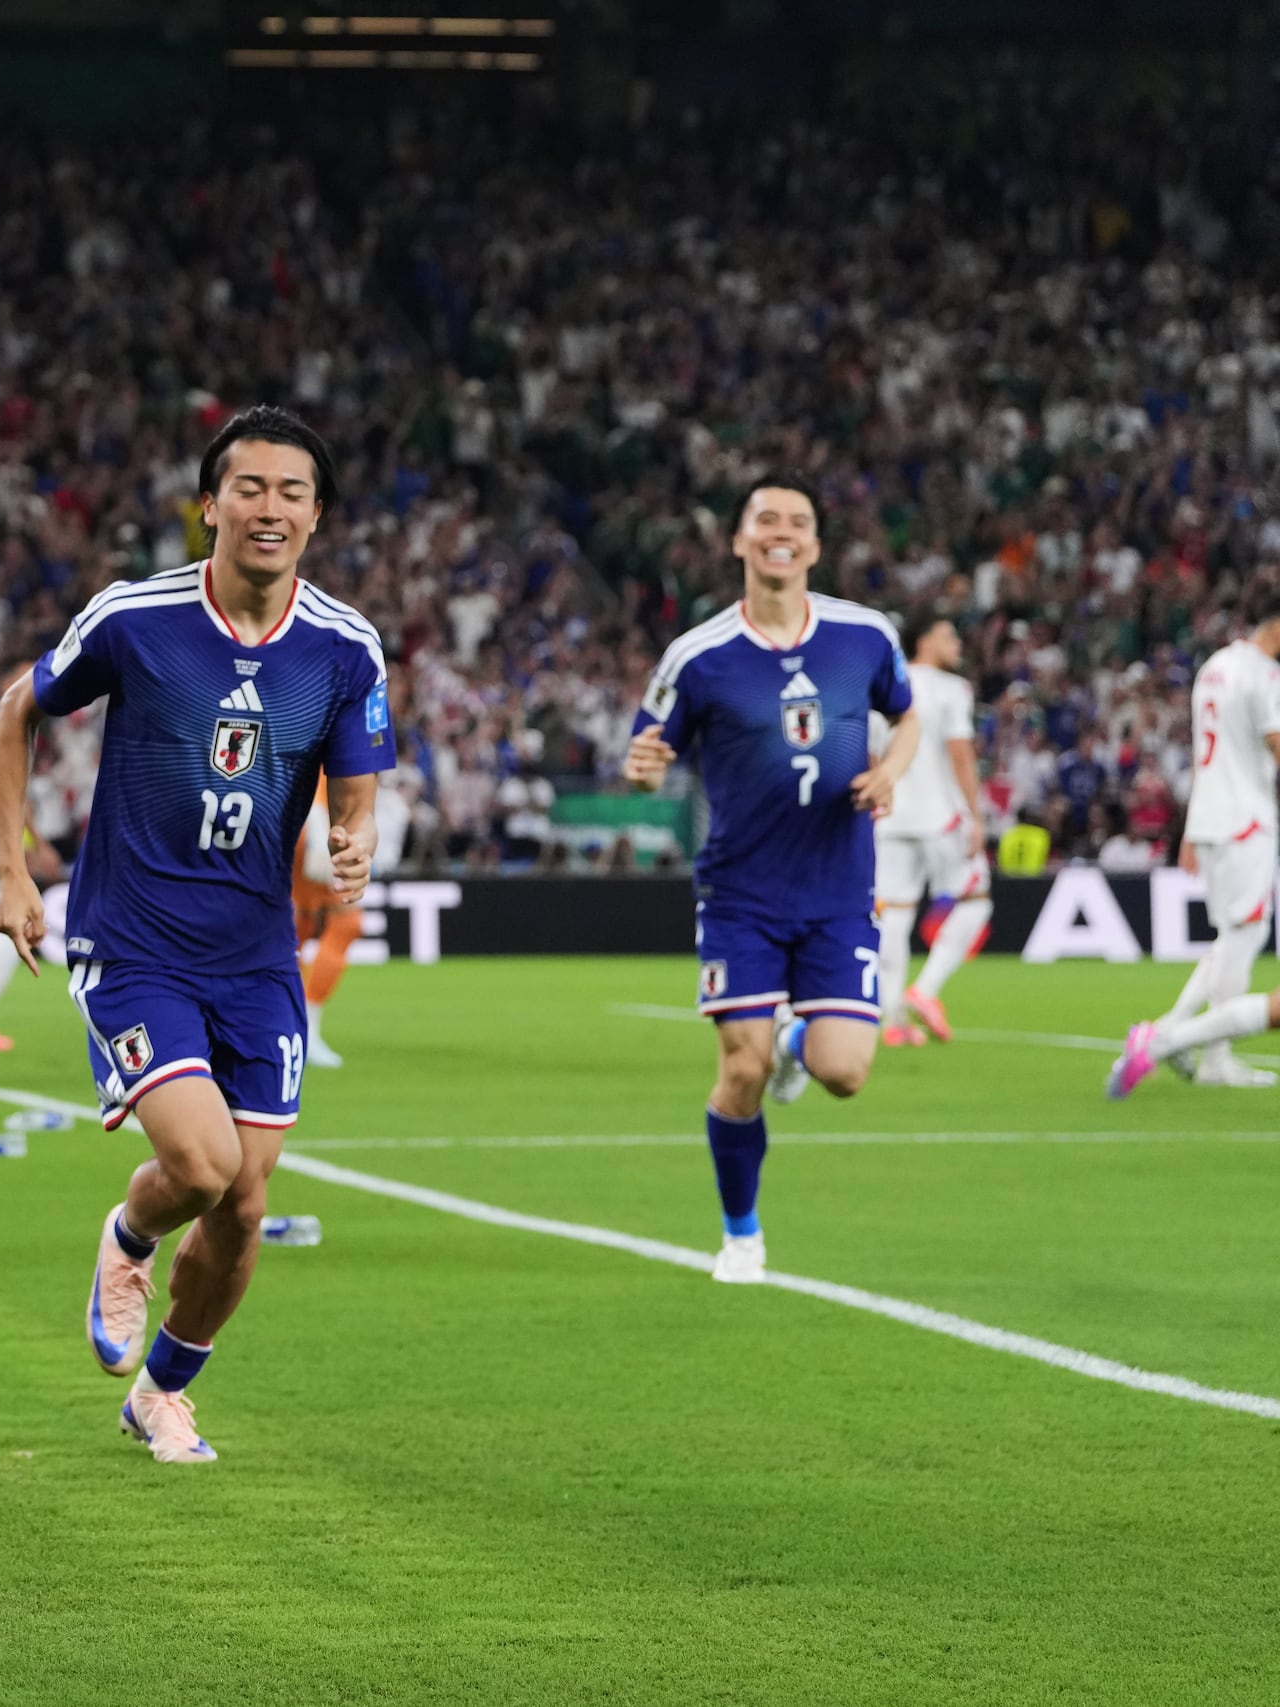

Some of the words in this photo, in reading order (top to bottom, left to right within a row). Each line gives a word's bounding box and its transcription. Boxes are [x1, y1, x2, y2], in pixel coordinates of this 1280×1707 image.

[791, 754, 820, 806] 7
[198, 789, 254, 850] 13
[854, 946, 879, 999] 7
[277, 1032, 303, 1103] 13
